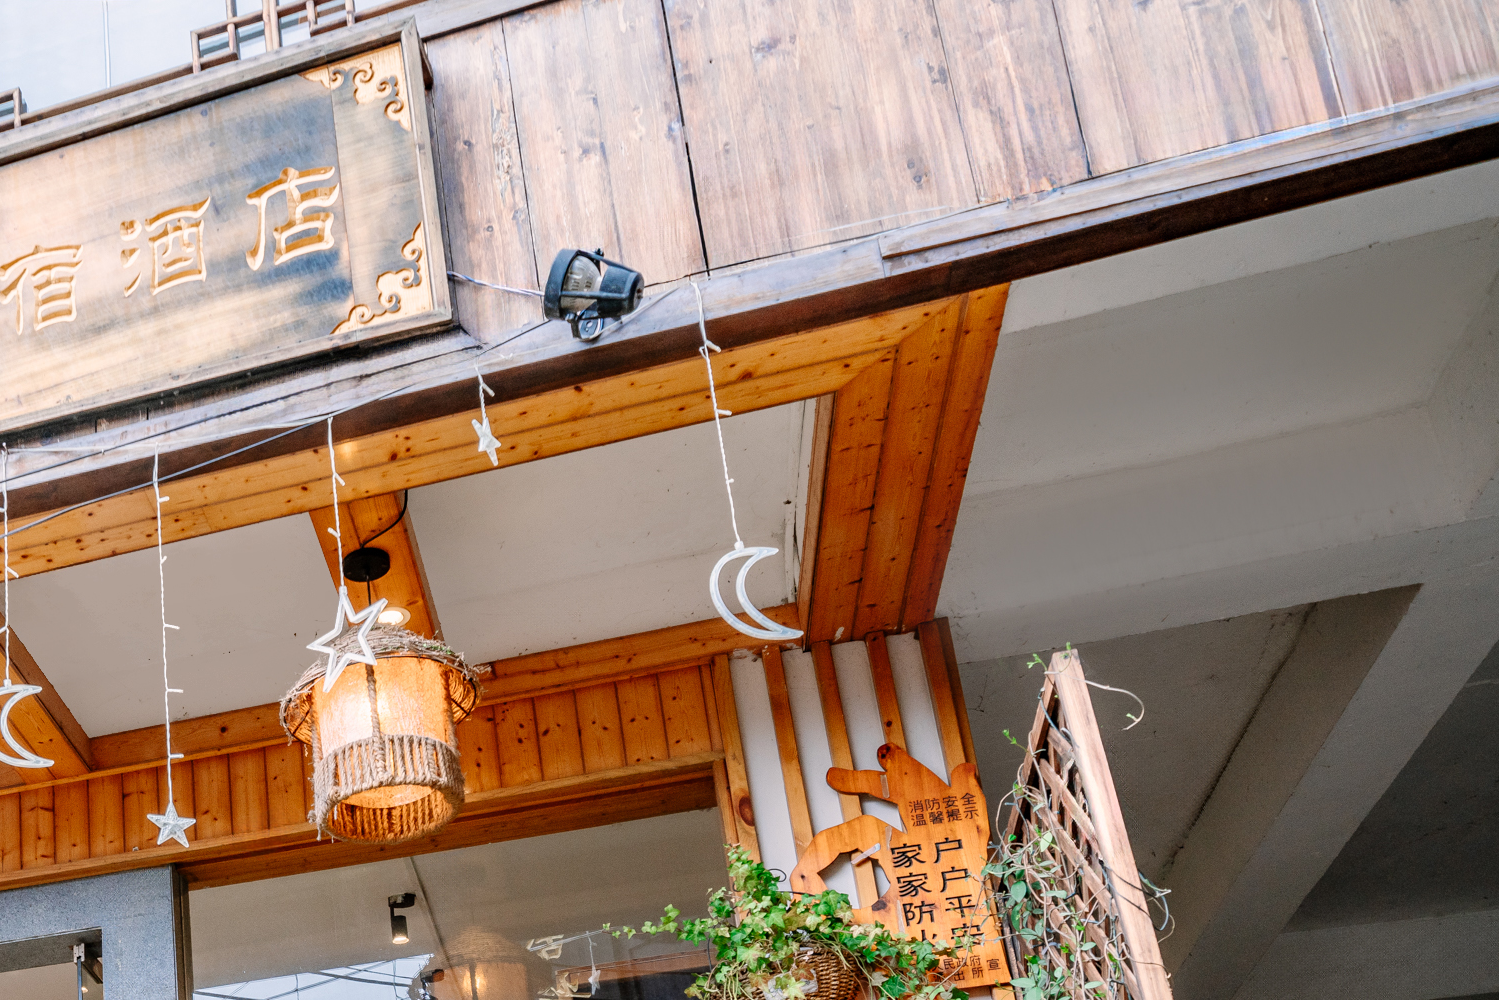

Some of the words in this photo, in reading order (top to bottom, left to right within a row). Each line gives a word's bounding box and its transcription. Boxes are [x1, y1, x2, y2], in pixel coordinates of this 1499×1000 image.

[908, 792, 977, 813] 消防安全
[910, 806, 979, 827] 温馨提示
